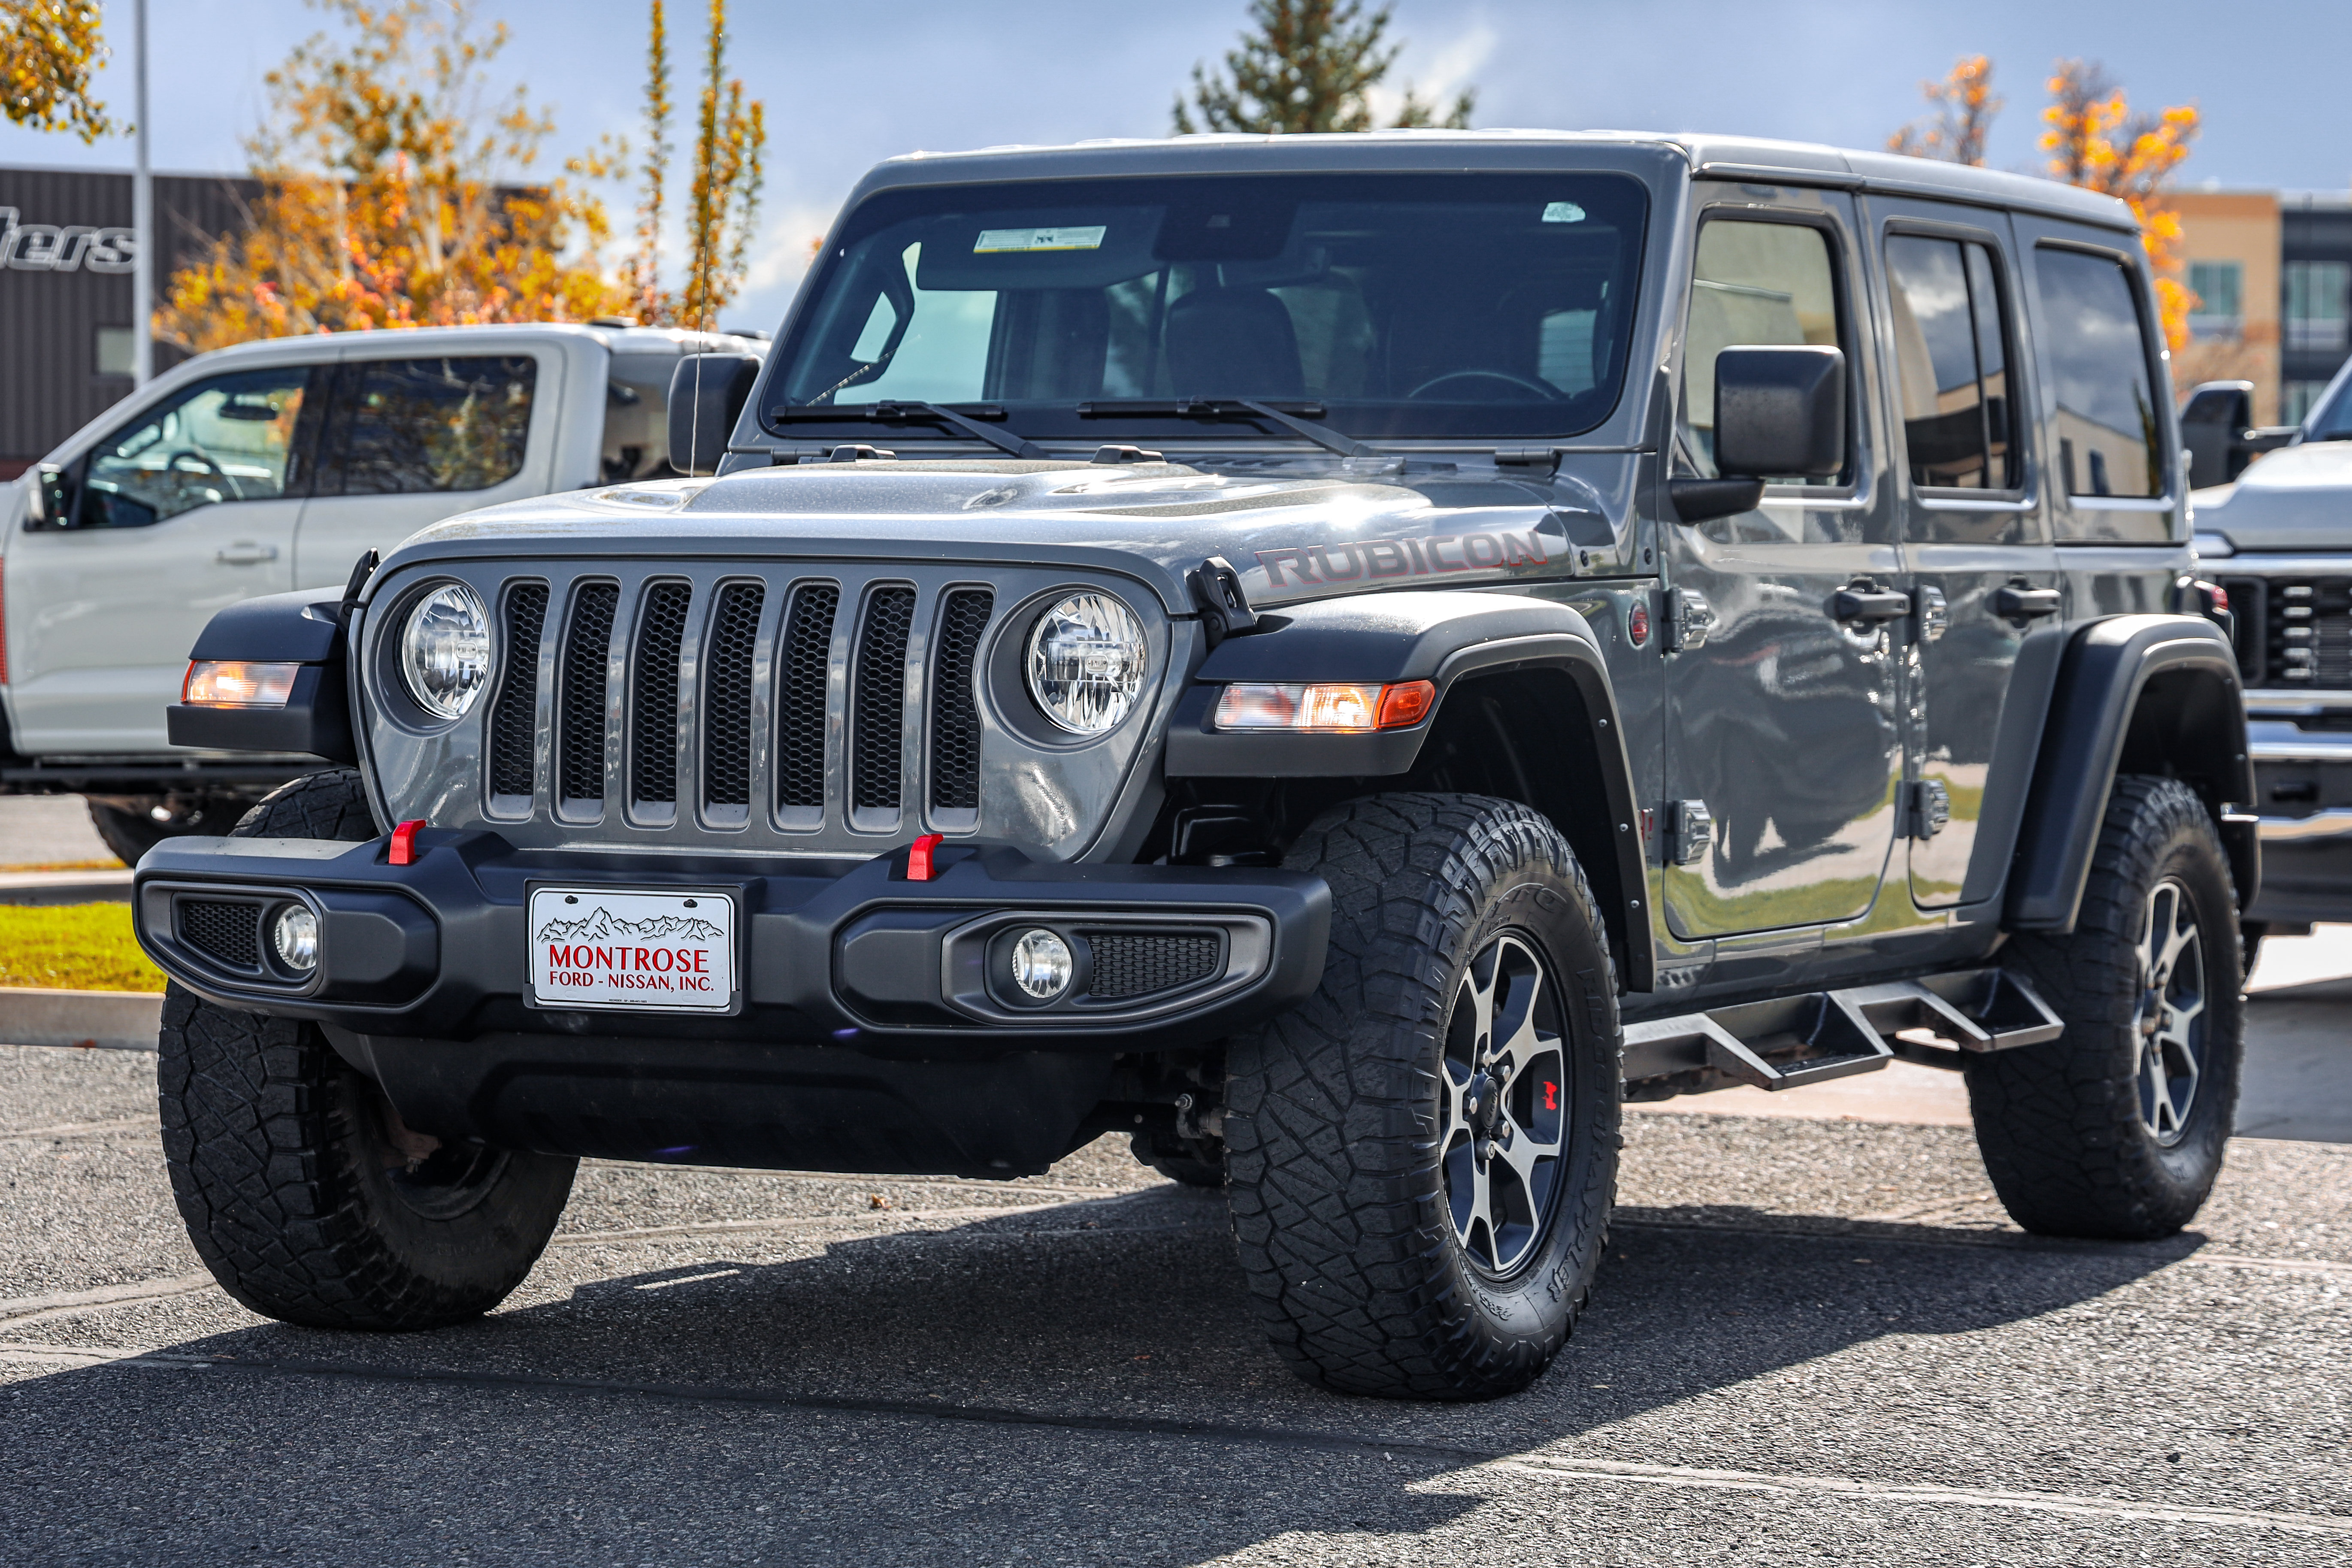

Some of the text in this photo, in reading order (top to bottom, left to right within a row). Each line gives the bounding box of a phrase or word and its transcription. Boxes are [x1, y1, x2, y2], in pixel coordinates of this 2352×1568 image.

[1254, 530, 1547, 588] RUBICON
[549, 944, 709, 973] MONTROSE
[550, 971, 594, 987] FORD
[608, 974, 675, 993] NISSAN,
[679, 976, 714, 992] INC.
